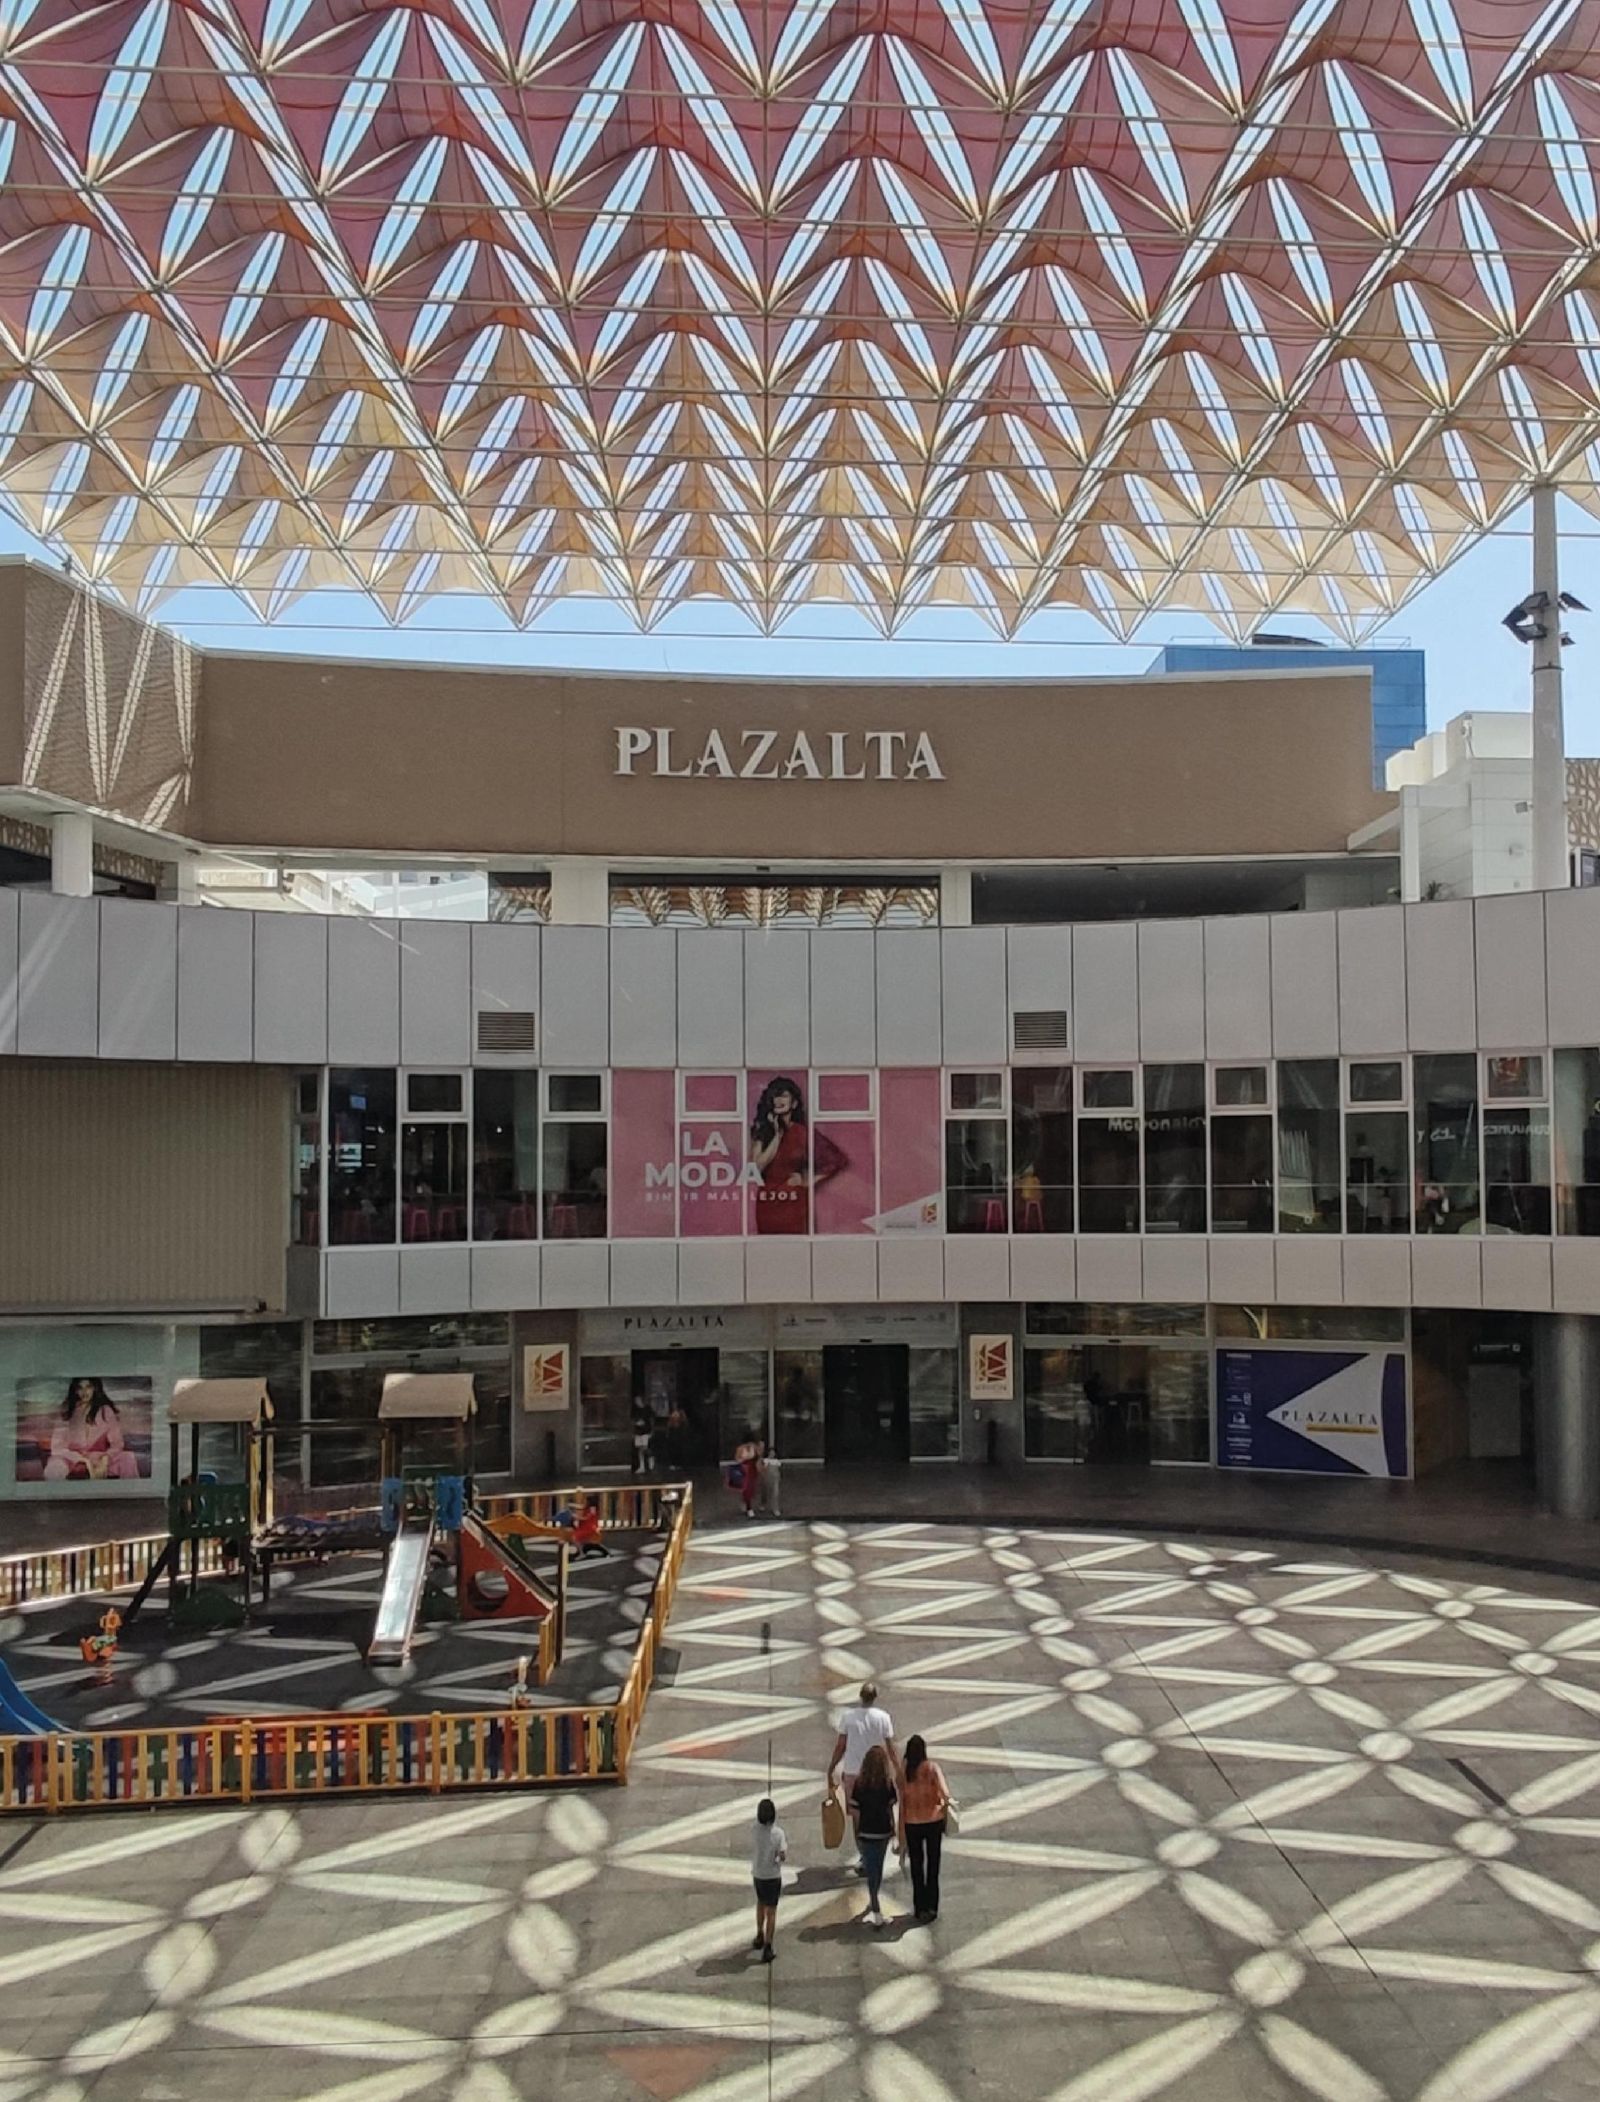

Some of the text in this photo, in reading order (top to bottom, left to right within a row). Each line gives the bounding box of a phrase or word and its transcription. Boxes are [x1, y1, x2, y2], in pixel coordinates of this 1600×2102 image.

[613, 726, 946, 780] PLAZALTA
[683, 1130, 730, 1157] LA
[644, 1162, 765, 1188] MODA
[750, 1190, 799, 1202] LEJOS
[624, 1314, 724, 1329] PLAZALTA
[1281, 1410, 1378, 1425] PLAZALTA
